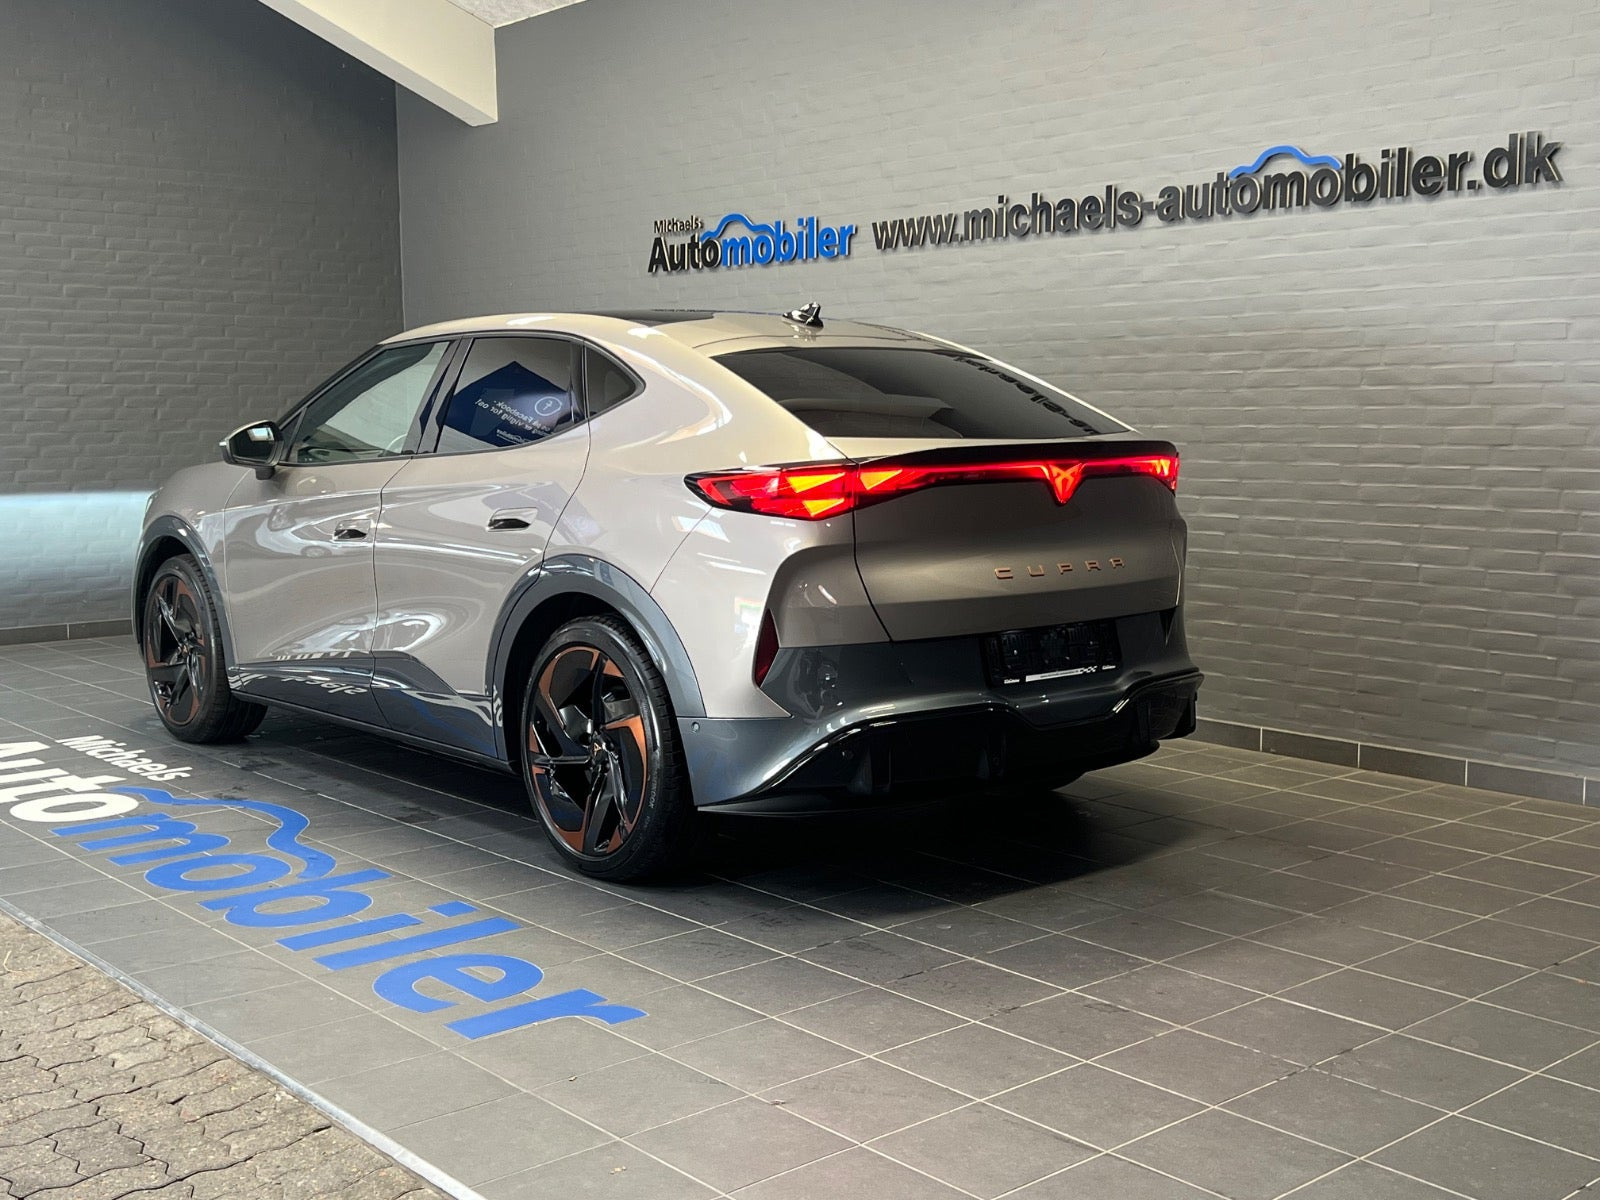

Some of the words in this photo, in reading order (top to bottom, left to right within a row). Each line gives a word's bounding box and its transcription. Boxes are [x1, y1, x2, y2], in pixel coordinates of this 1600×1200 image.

[871, 131, 1563, 250] www.michaels-automobiler.dk
[648, 216, 857, 273] Automobiler
[654, 215, 702, 234] Michaels
[994, 557, 1125, 579] CUPRA
[55, 735, 193, 782] Michaels
